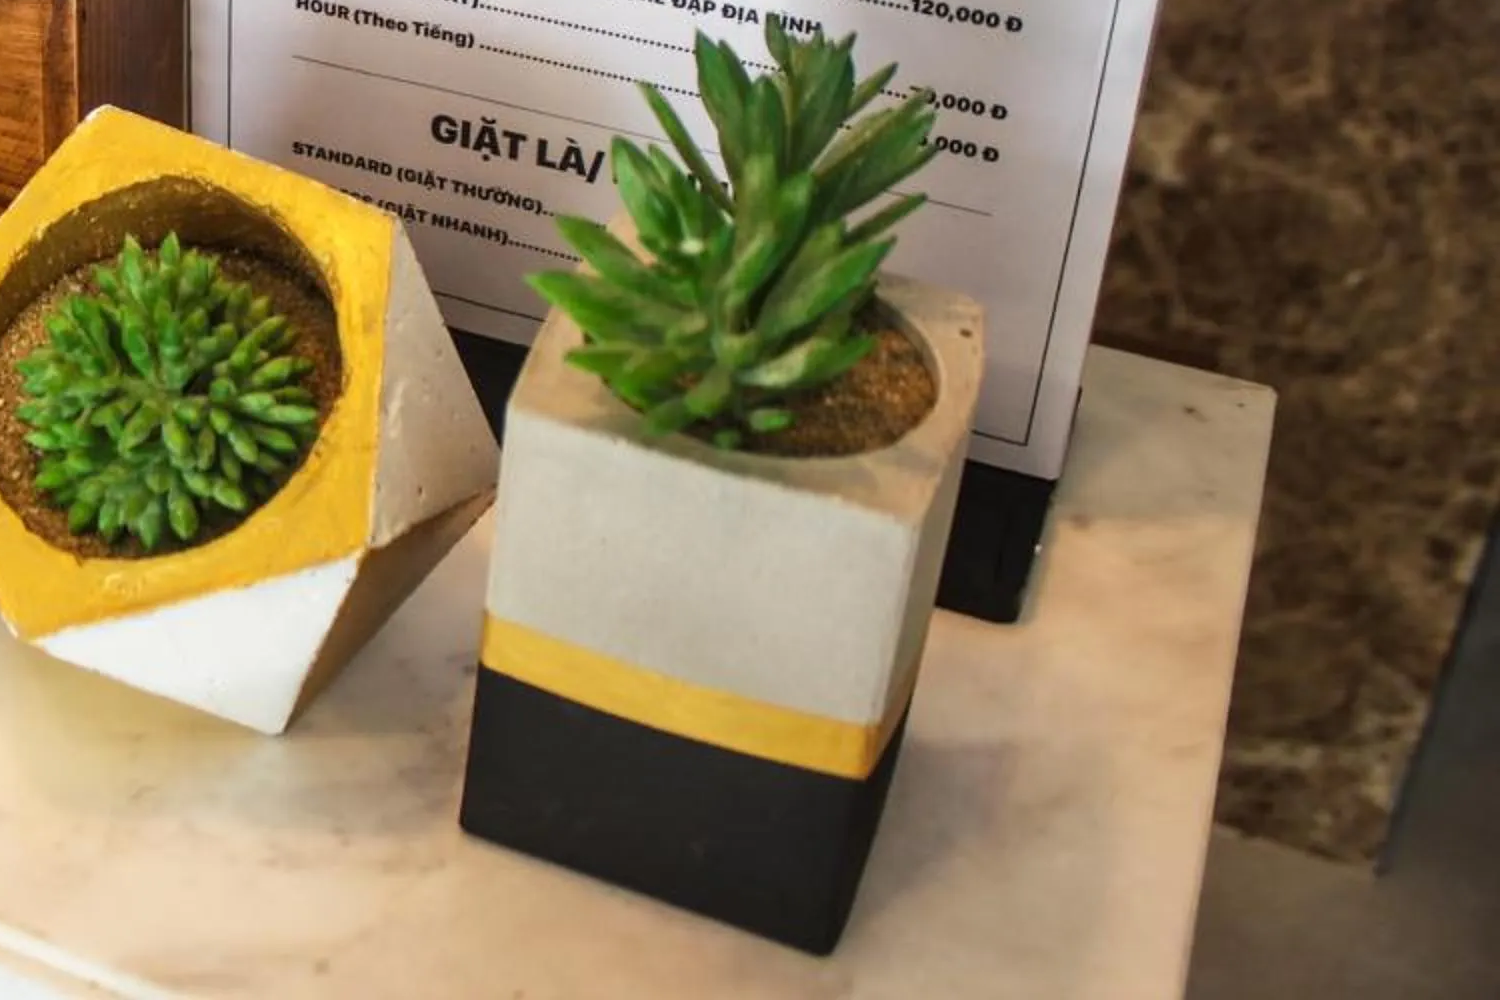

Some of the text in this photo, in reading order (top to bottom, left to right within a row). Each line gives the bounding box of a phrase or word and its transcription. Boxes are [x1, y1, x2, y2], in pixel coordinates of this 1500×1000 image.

[353, 8, 408, 33] (Theo
[412, 20, 476, 49] Tiếng)
[721, 3, 759, 25] ĐỊA
[768, 9, 821, 34] ÌNH
[910, 86, 986, 116] 0,000
[431, 114, 528, 163] GIẶT
[291, 140, 393, 178] STANDARD
[431, 213, 509, 246] NHANH)
